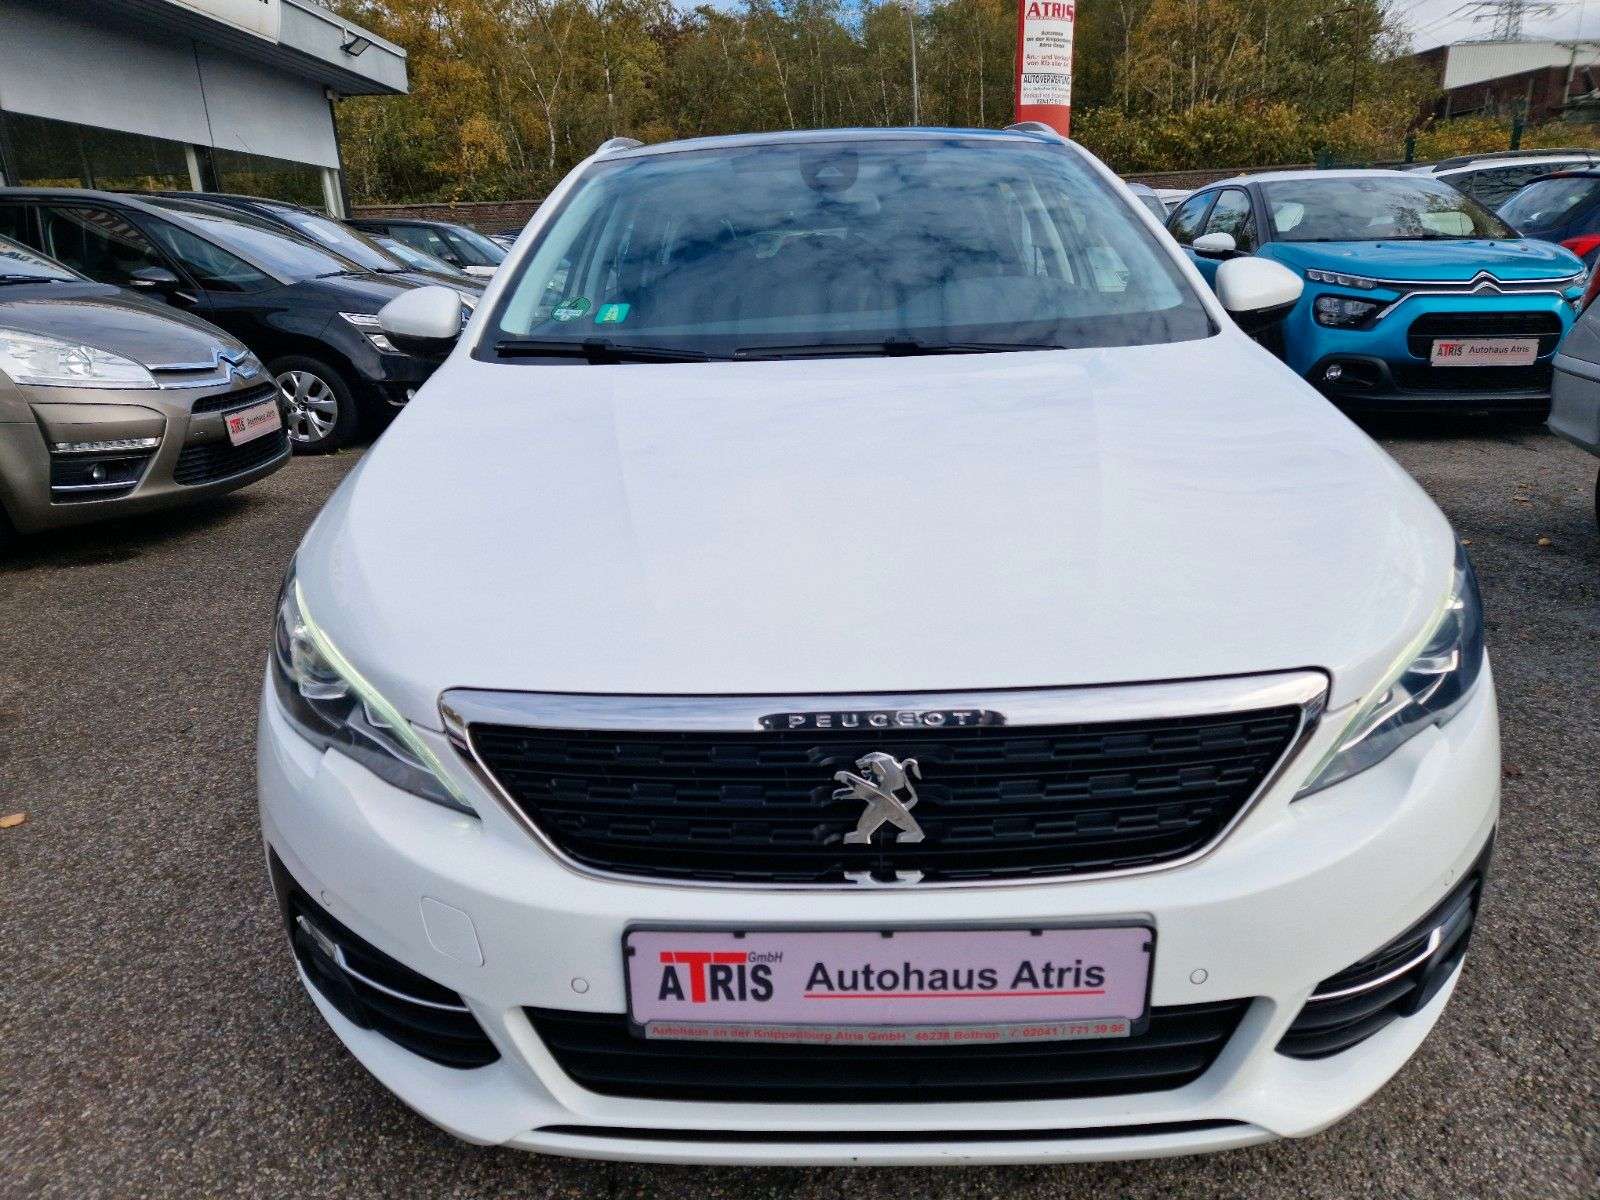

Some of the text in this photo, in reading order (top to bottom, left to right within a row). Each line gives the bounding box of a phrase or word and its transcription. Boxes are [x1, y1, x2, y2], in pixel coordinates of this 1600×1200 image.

[1026, 2, 1073, 22] ATRIS
[1436, 343, 1530, 357] ATRIS Autohaus Atris
[788, 711, 973, 729] PEUGEOT
[658, 951, 784, 1004] ATRIS GmbH
[805, 959, 1106, 992] Autohaus Atris
[652, 1025, 709, 1037] Autohaus
[713, 1027, 728, 1038] an
[731, 1027, 750, 1039] der
[836, 1031, 865, 1041] Atris
[867, 1031, 906, 1041] GmbH
